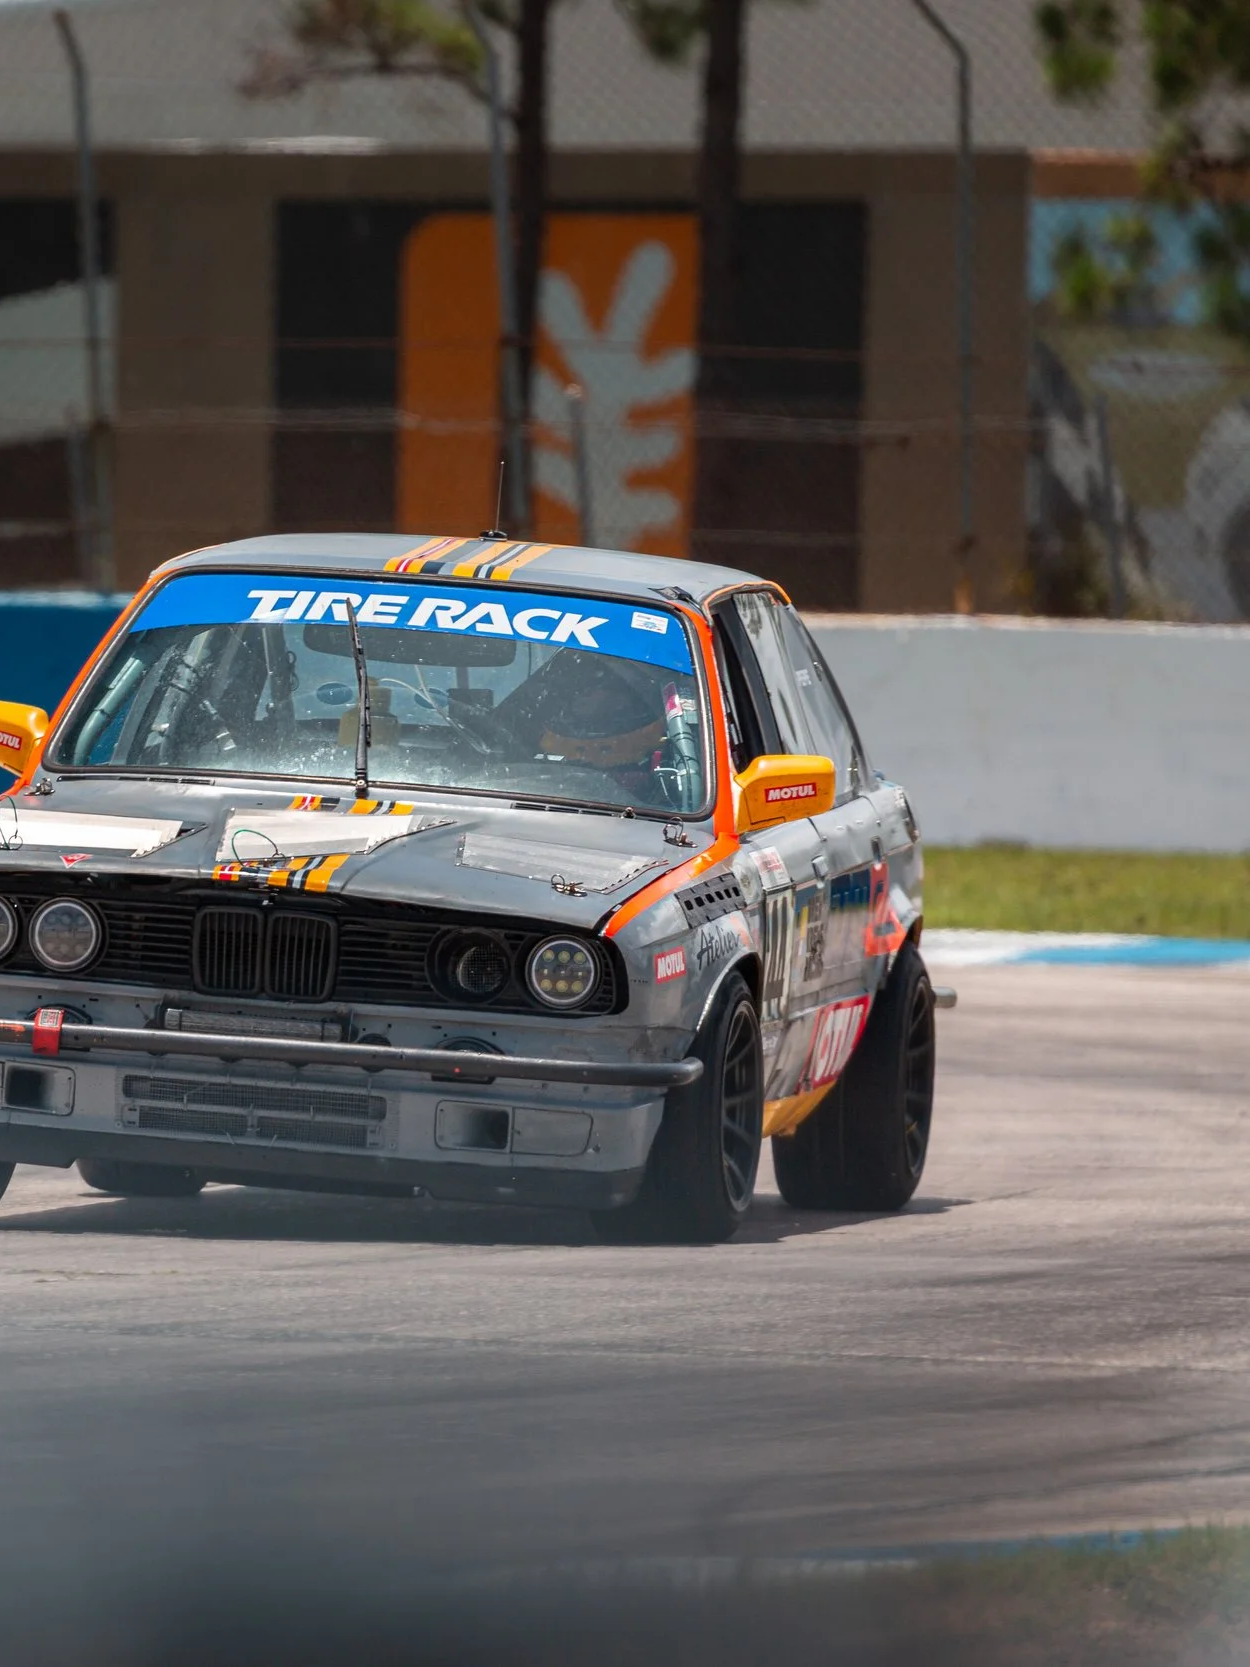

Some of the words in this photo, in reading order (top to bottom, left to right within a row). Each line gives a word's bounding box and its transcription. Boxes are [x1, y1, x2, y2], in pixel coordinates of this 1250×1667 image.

[247, 590, 409, 623] TIRE
[407, 599, 610, 649] RACK
[767, 784, 815, 801] MOTUL
[656, 950, 685, 979] MOTUL
[696, 925, 742, 970] Atelier
